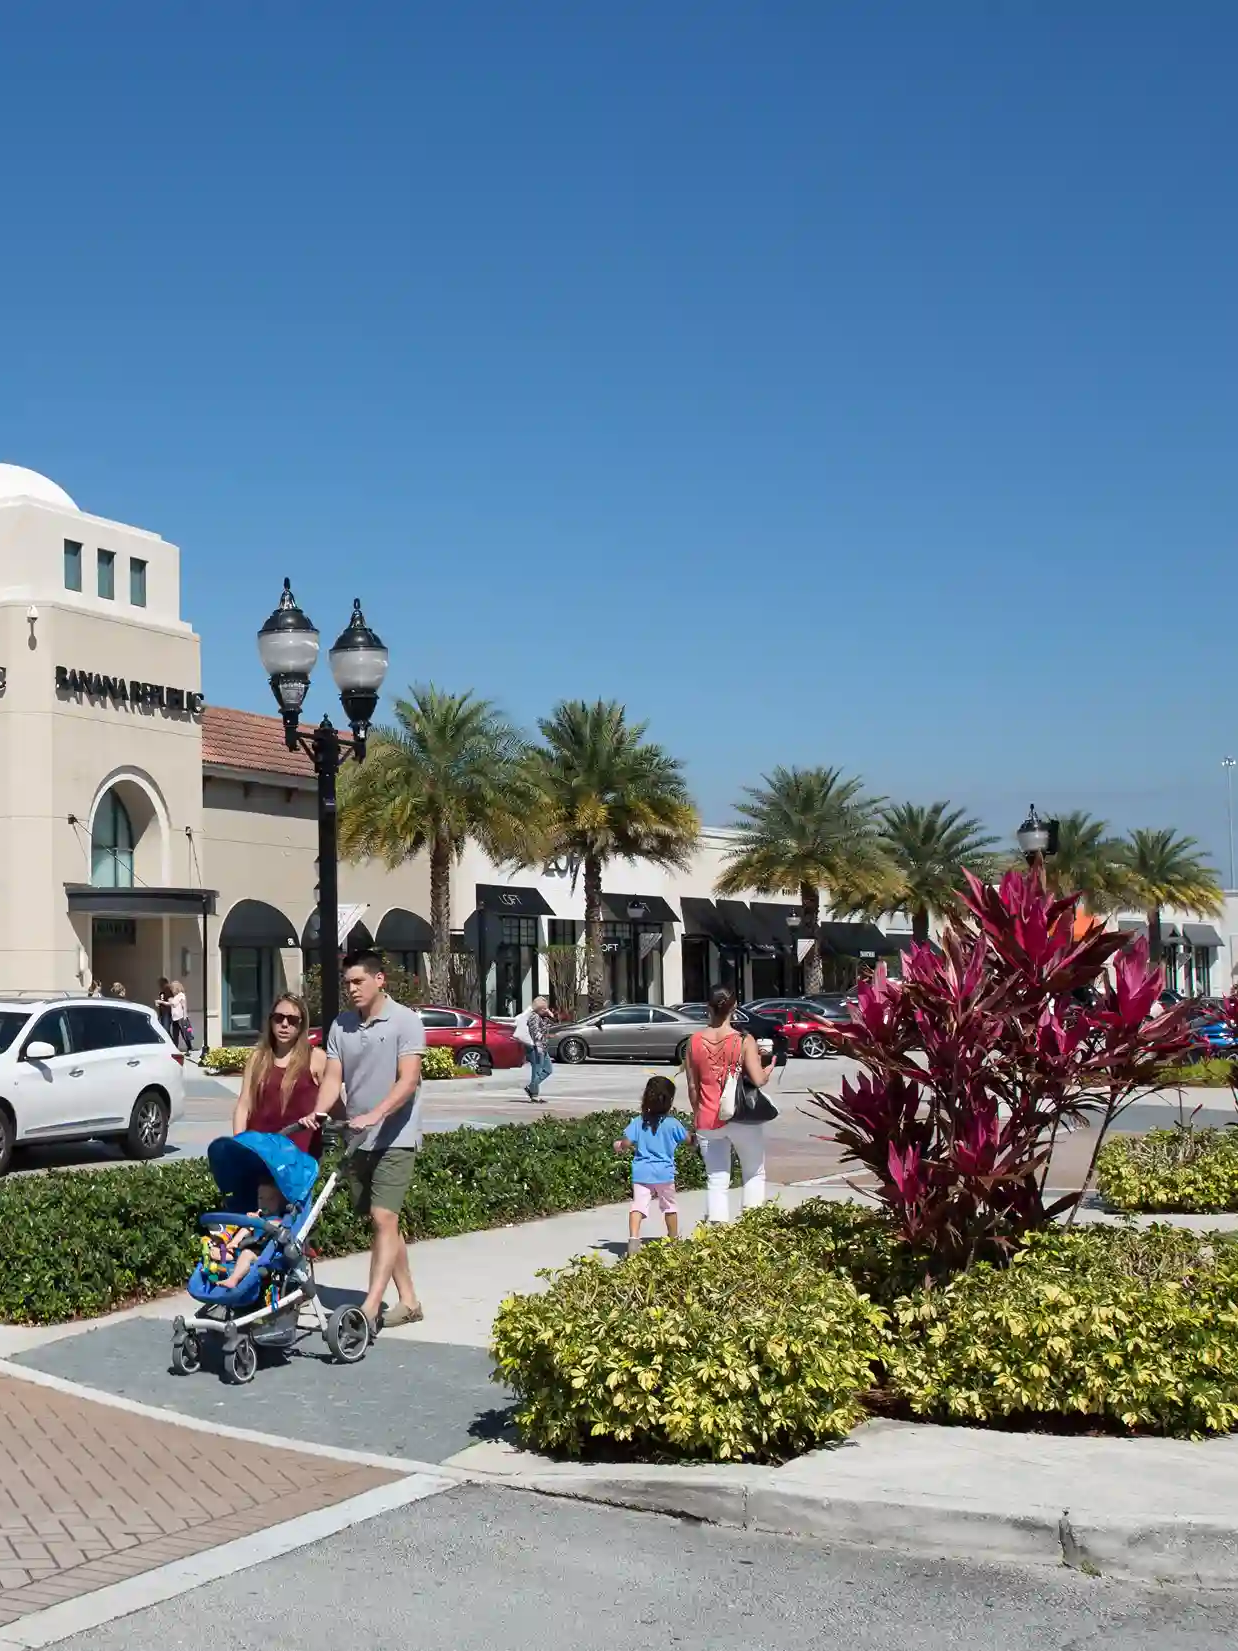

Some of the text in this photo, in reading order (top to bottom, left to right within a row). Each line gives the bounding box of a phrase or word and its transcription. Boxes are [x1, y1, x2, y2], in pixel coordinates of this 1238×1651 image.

[55, 666, 205, 714] BANANA REPUBLIC
[498, 893, 523, 905] LOFT
[600, 943, 619, 952] OFT
